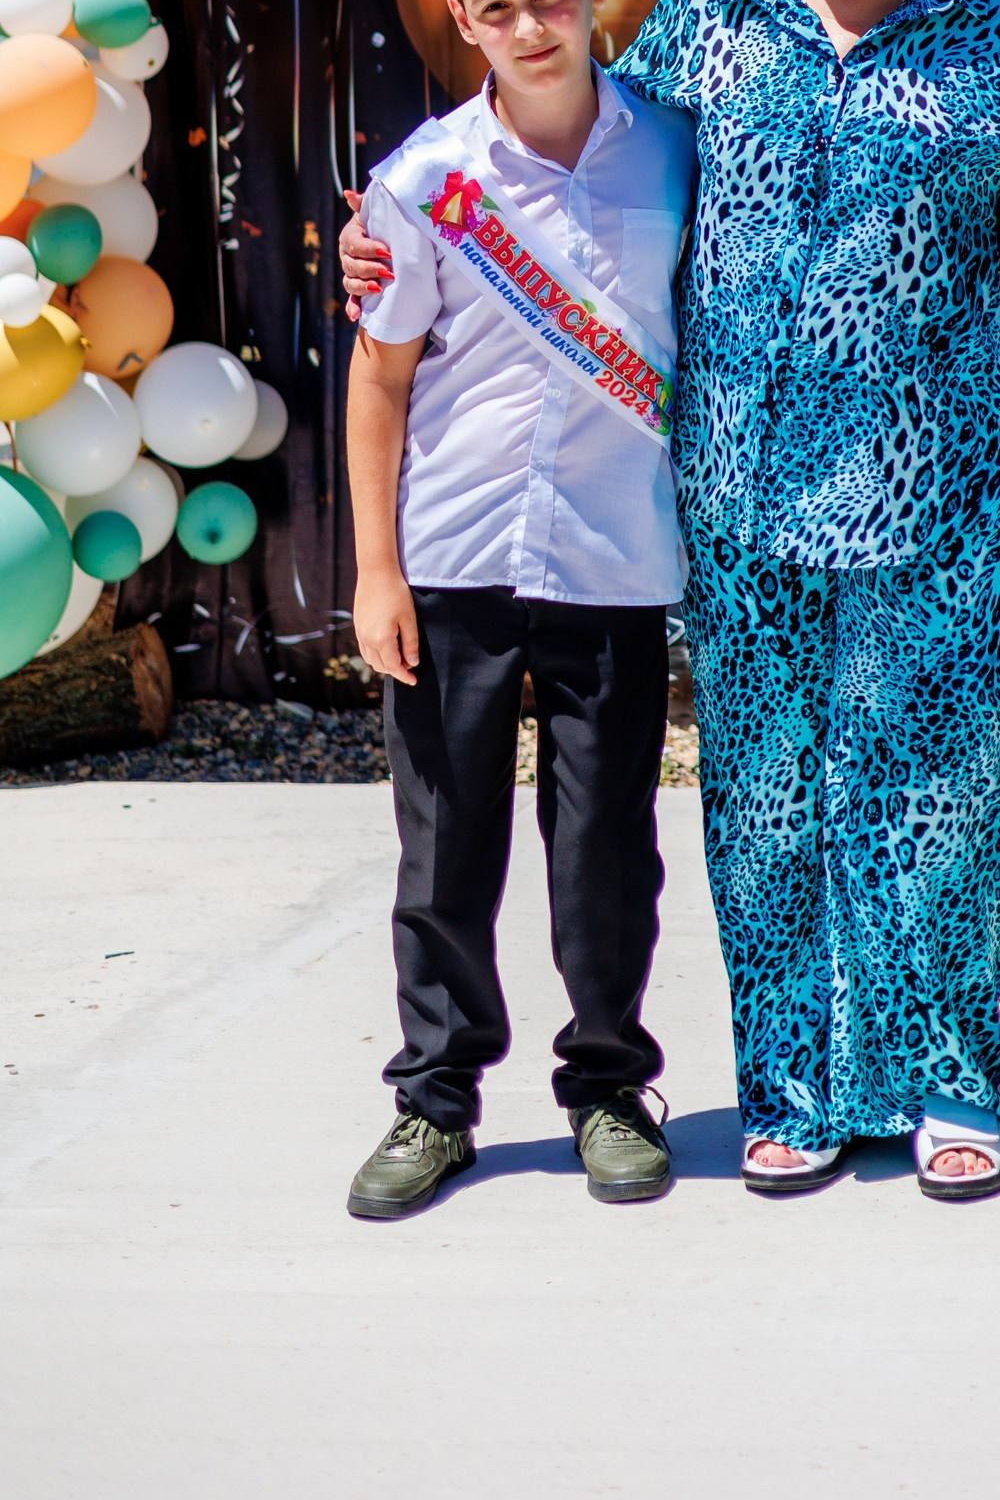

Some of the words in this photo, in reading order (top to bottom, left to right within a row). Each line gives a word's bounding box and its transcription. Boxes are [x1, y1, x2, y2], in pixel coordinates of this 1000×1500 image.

[459, 241, 551, 329] начальной
[541, 327, 599, 377] школы
[594, 370, 652, 417] 2024
[472, 213, 665, 402] ВЫПУСКНИК
